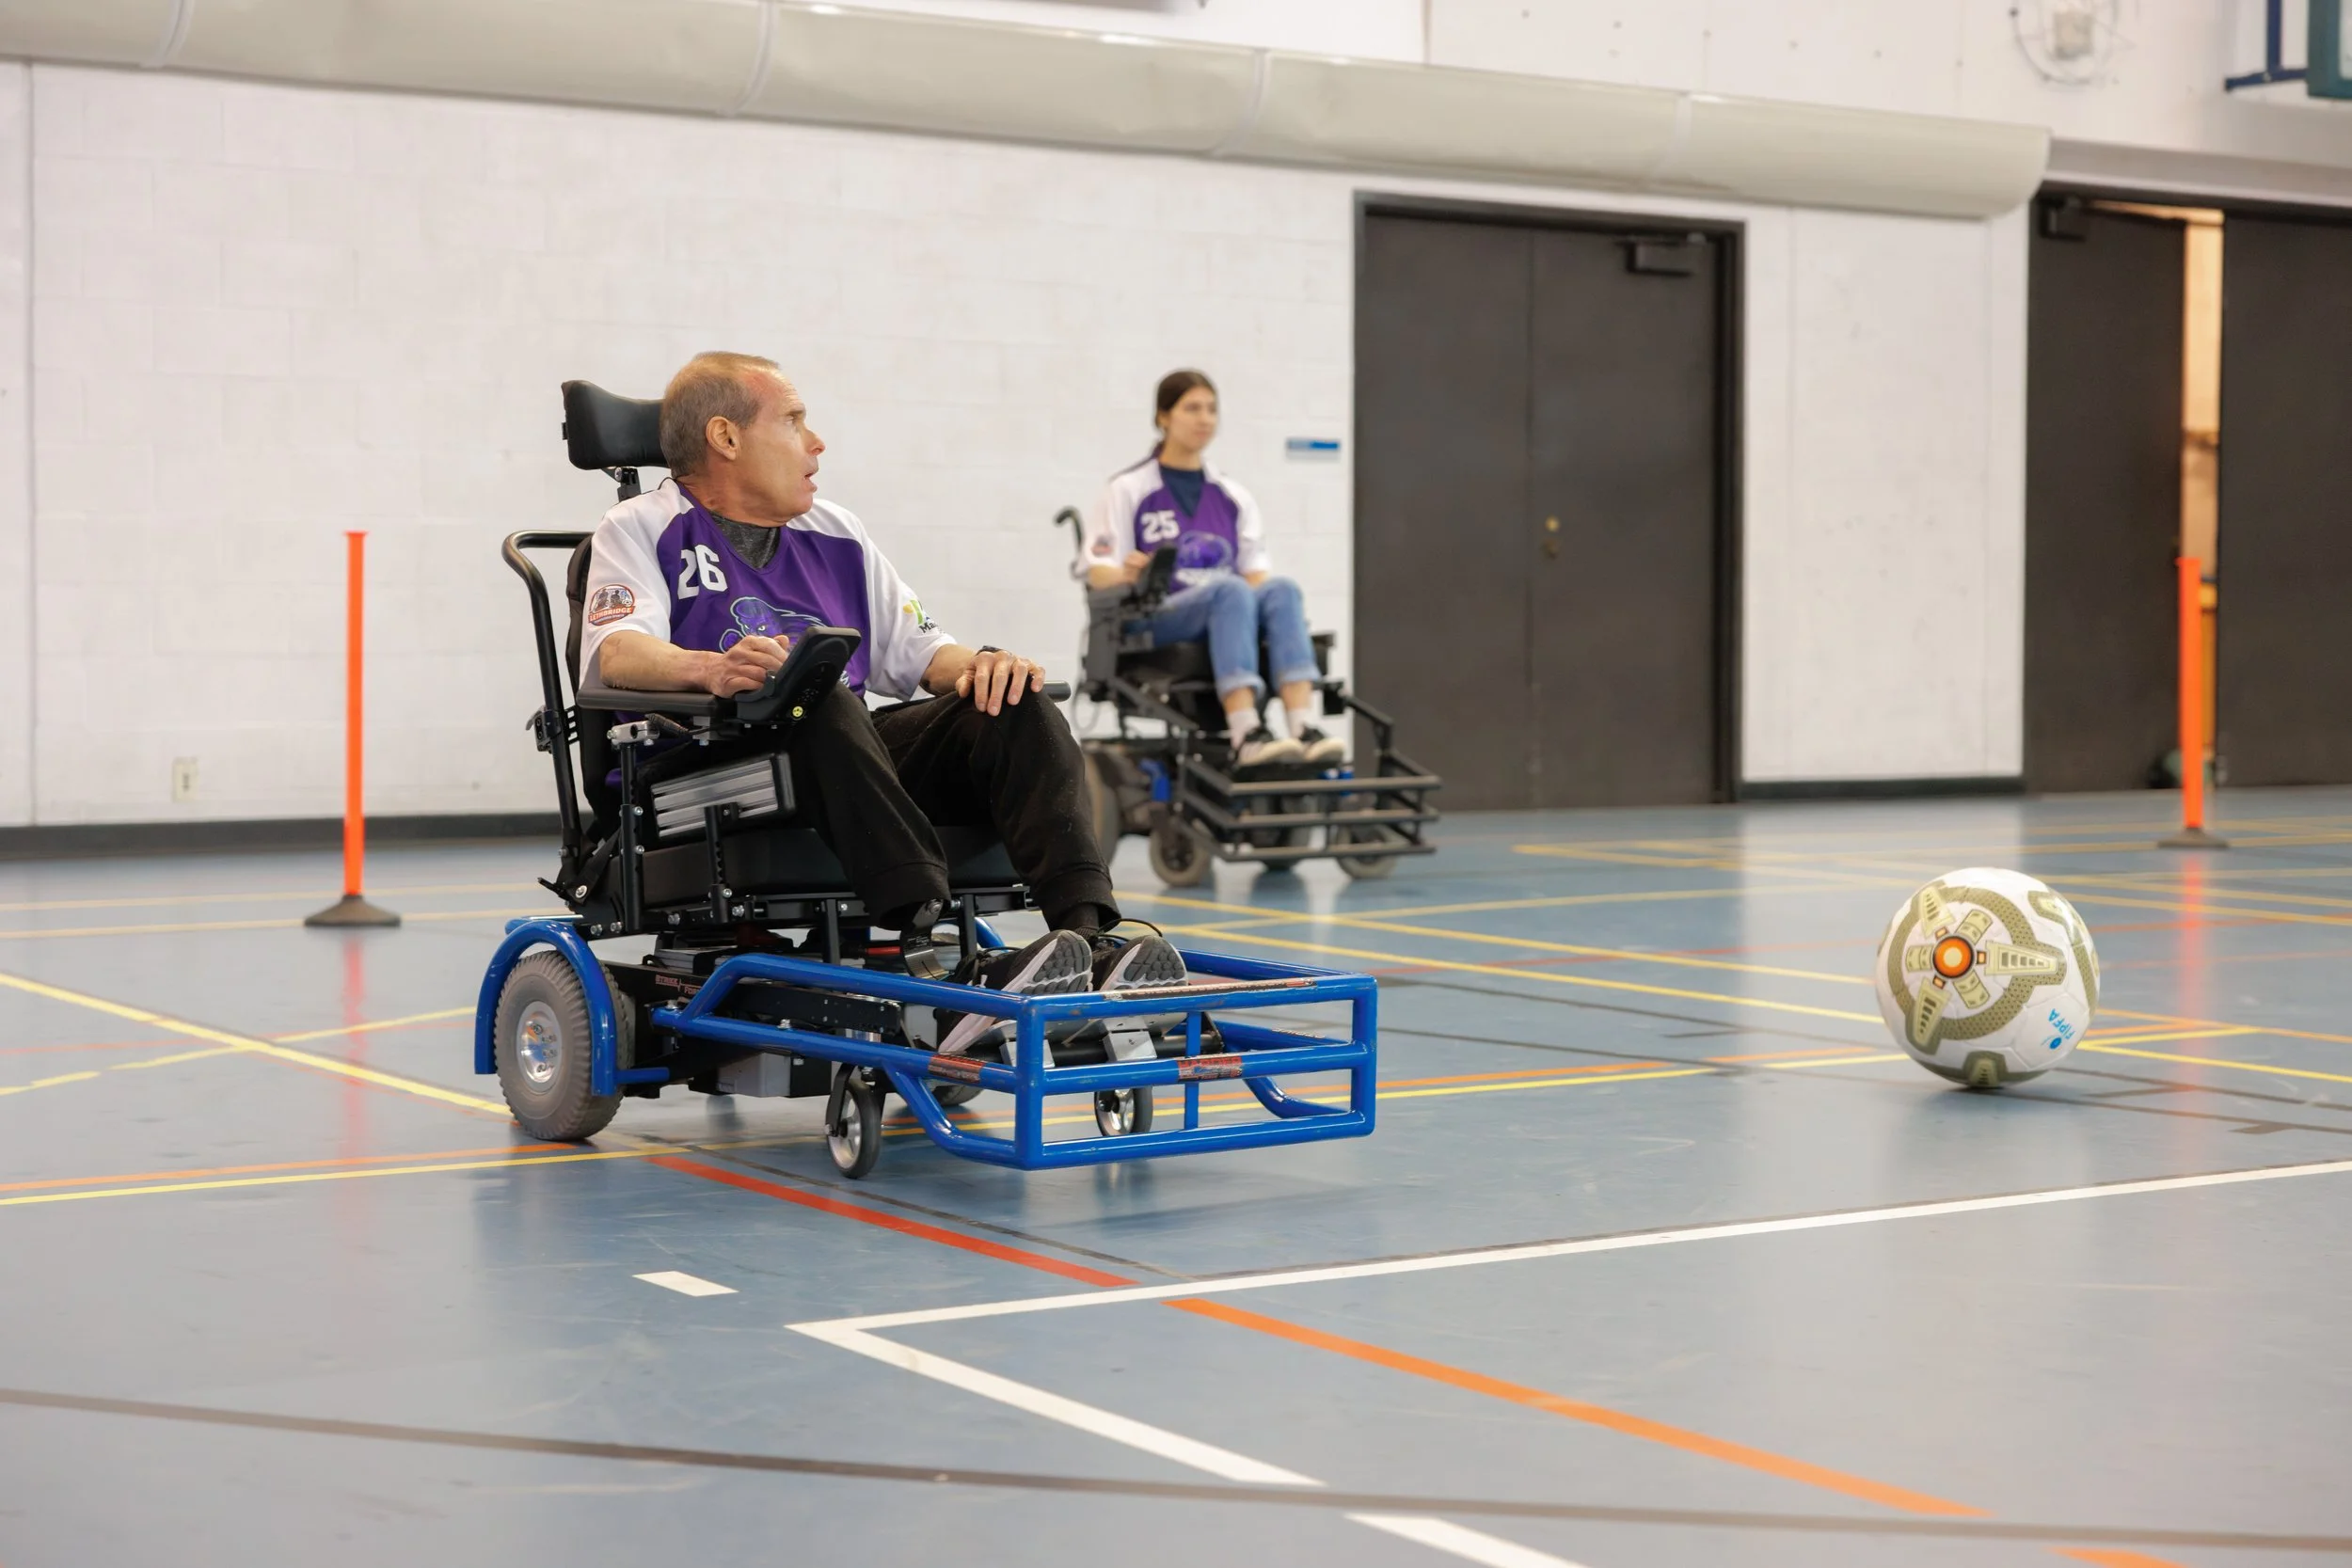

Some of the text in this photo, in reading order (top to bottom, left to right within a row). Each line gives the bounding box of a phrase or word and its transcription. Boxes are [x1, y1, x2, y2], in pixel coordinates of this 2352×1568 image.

[1140, 509, 1180, 544] 25
[677, 544, 728, 600] 26
[589, 607, 632, 622] LETHBRIDGE
[2048, 1008, 2076, 1040] FIPFA
